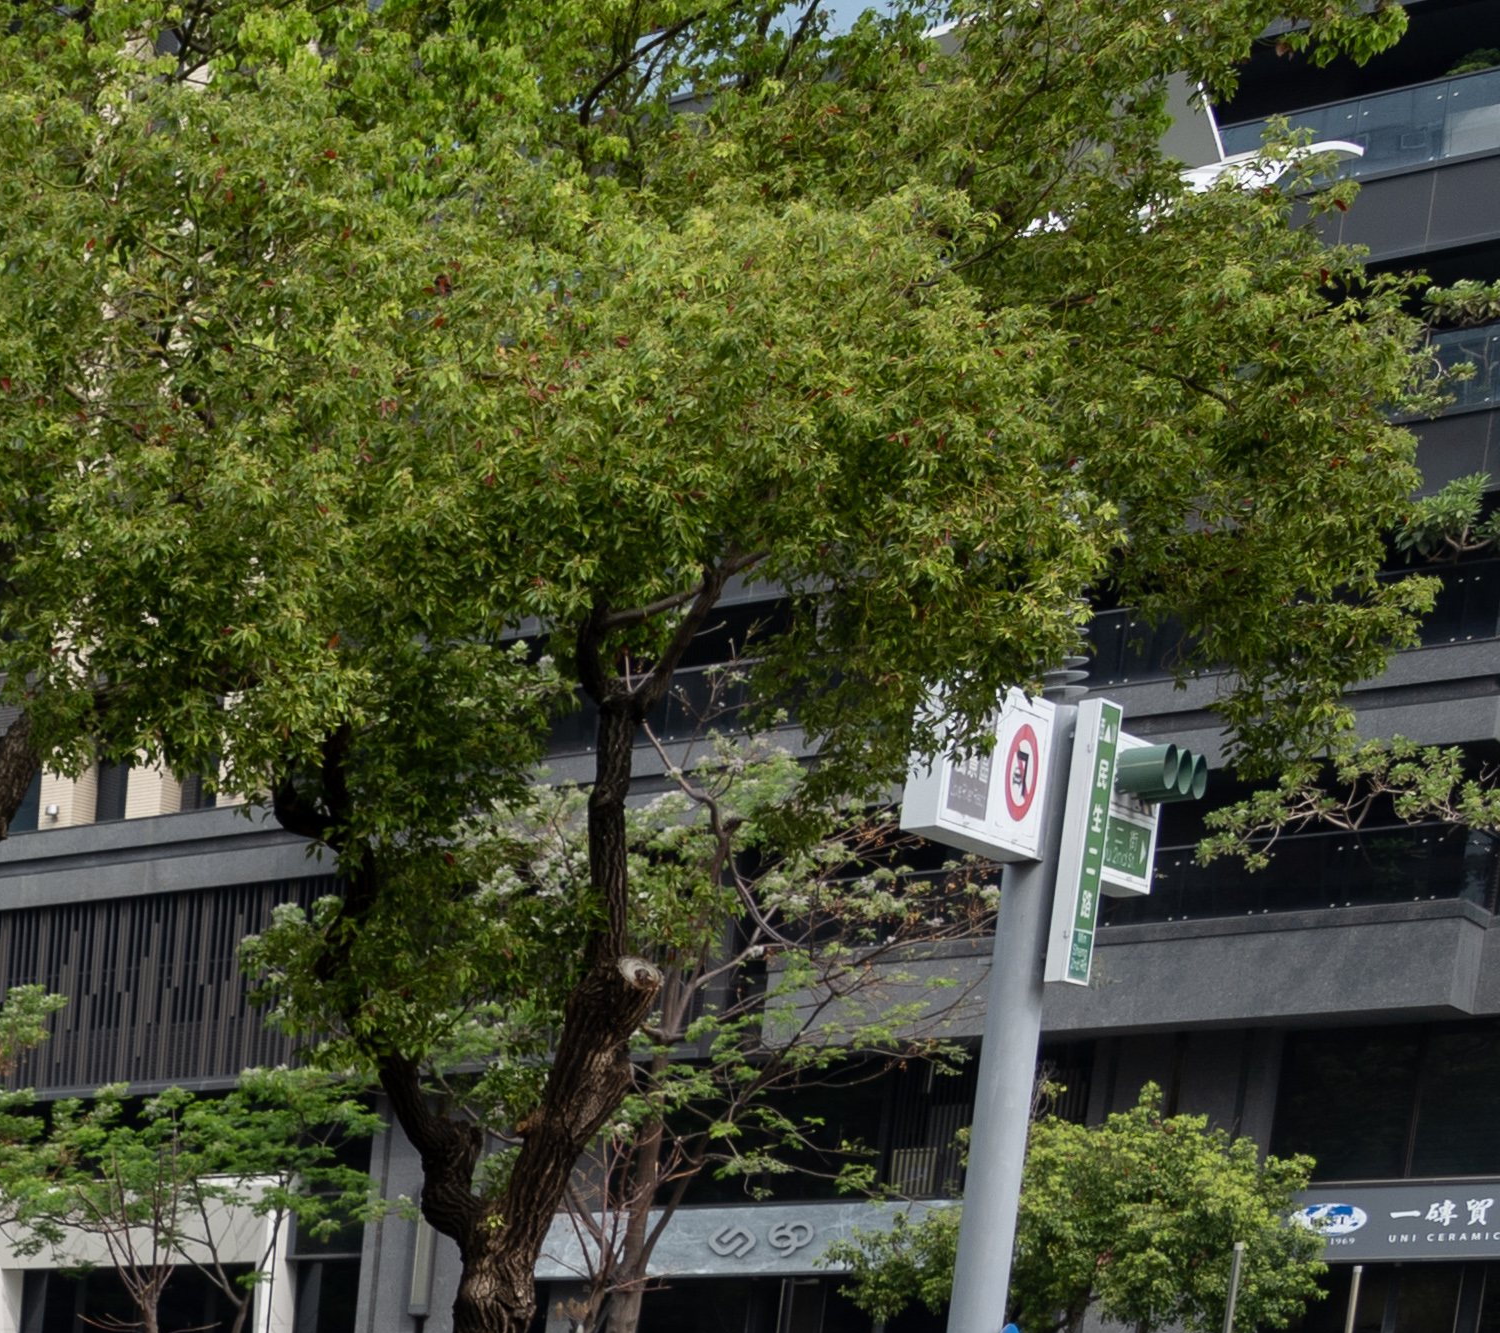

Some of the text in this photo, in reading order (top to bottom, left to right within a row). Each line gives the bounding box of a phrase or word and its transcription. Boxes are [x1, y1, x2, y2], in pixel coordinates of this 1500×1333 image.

[1079, 758, 1109, 919] 民生二路
[1330, 1237, 1355, 1246] 1969
[1388, 1233, 1417, 1243] UNI
